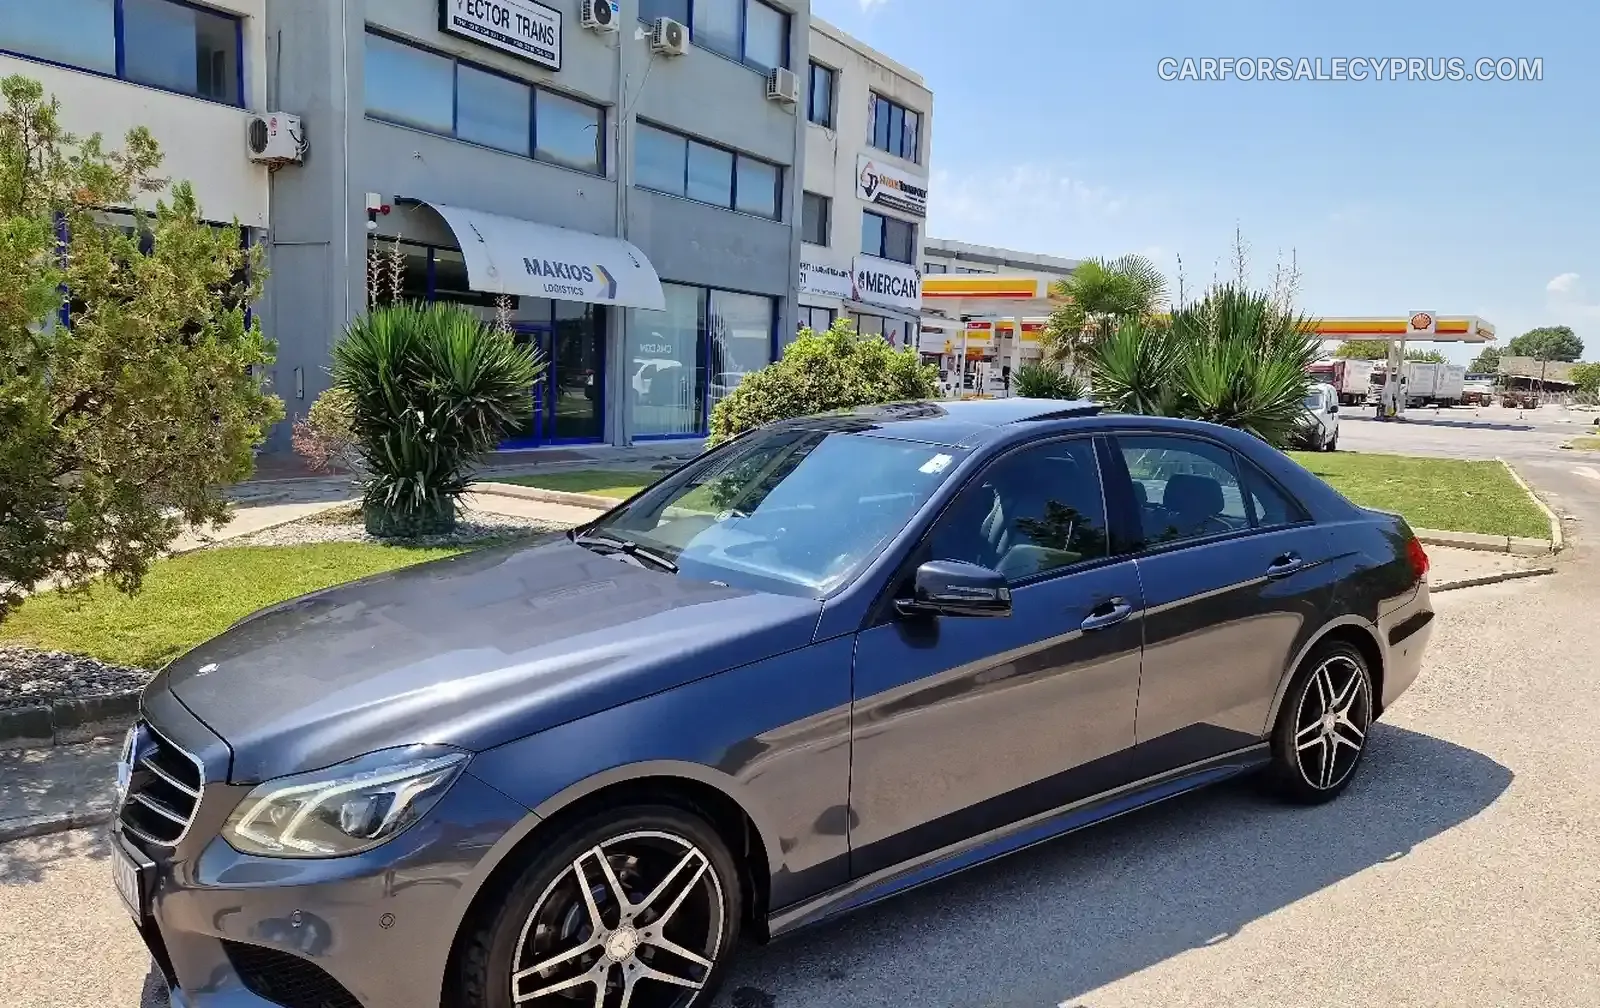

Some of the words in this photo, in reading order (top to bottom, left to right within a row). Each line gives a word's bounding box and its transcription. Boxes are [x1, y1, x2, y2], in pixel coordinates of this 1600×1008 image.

[516, 13, 554, 46] TRANS
[523, 257, 594, 283] MAKIOS
[543, 283, 584, 296] LOGISTICS
[865, 270, 917, 299] MERCAN
